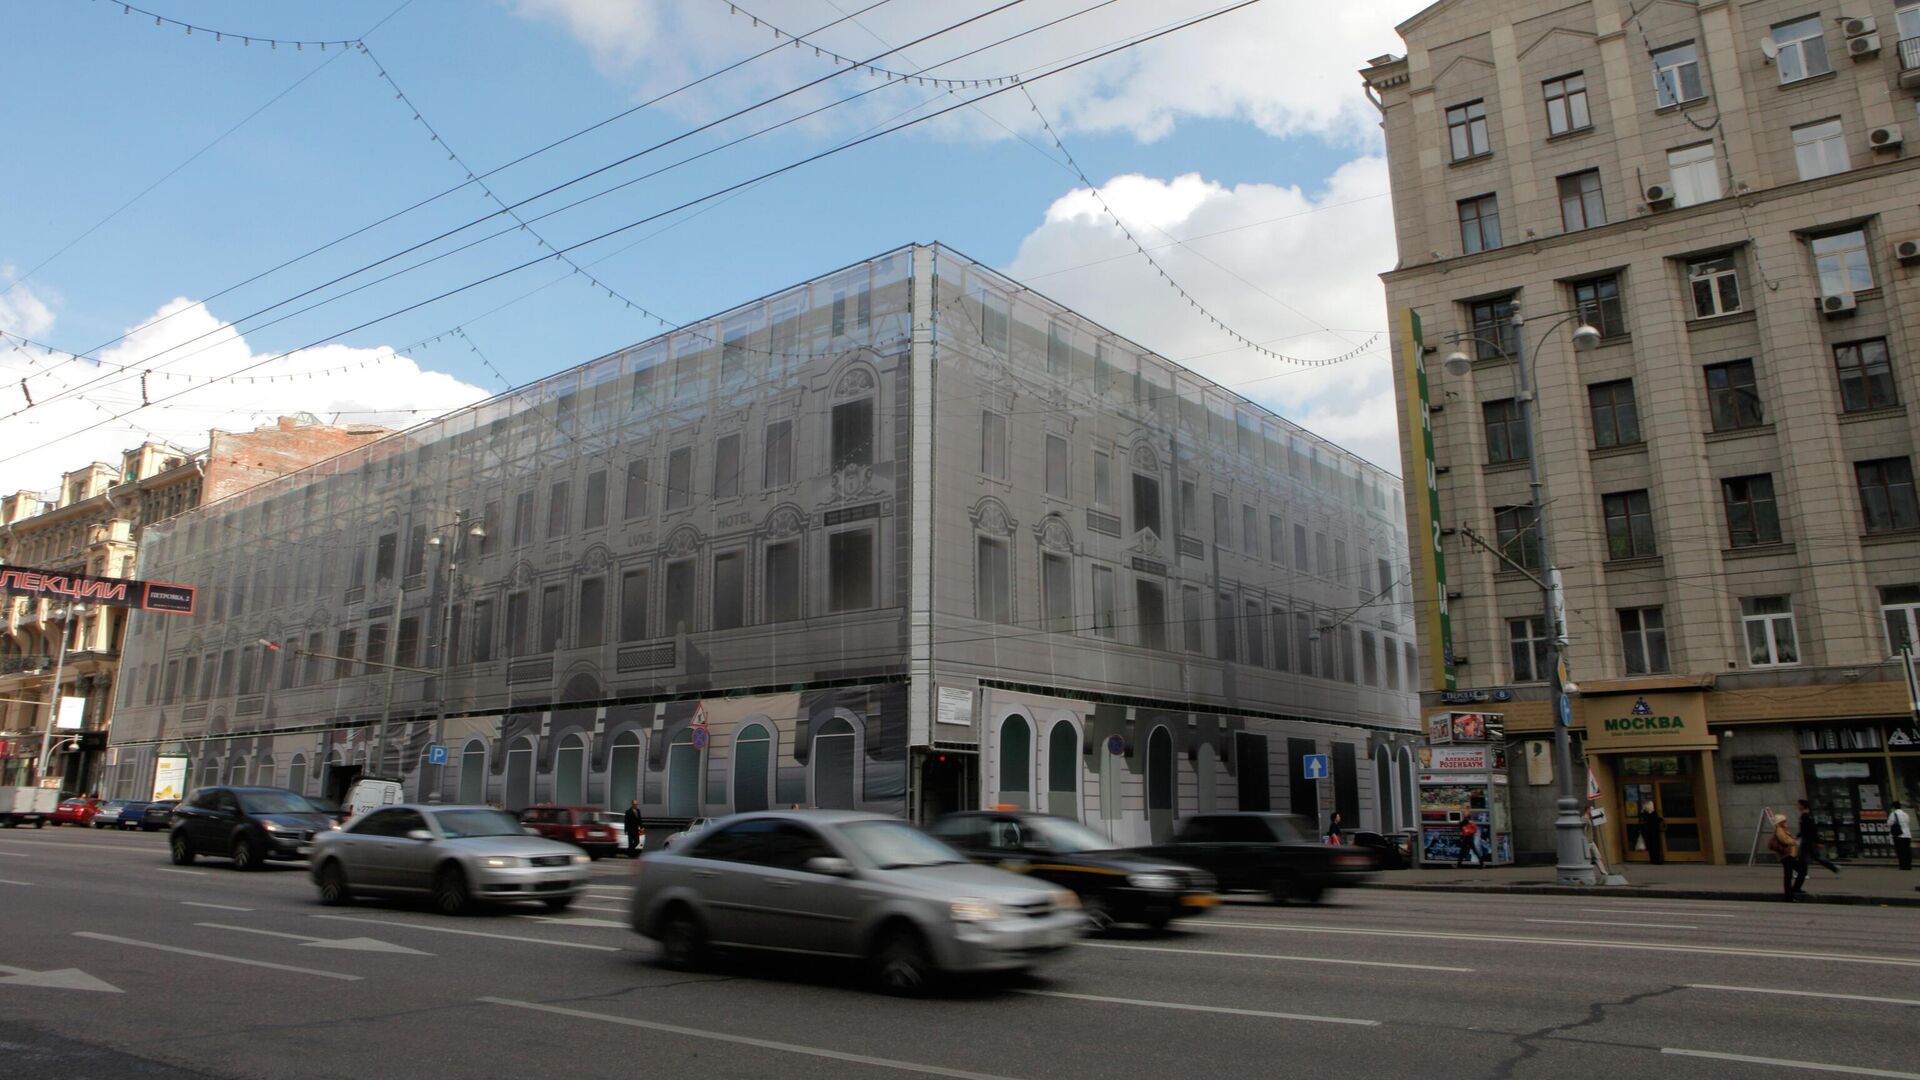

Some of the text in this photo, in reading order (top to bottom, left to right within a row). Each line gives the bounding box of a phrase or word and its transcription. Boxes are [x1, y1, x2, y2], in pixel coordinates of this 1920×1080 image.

[717, 512, 753, 529] HOTEL
[0, 571, 126, 601] ЛЕКЦИИ
[1499, 690, 1505, 698] 8
[1604, 716, 1685, 731] МОСКВА
